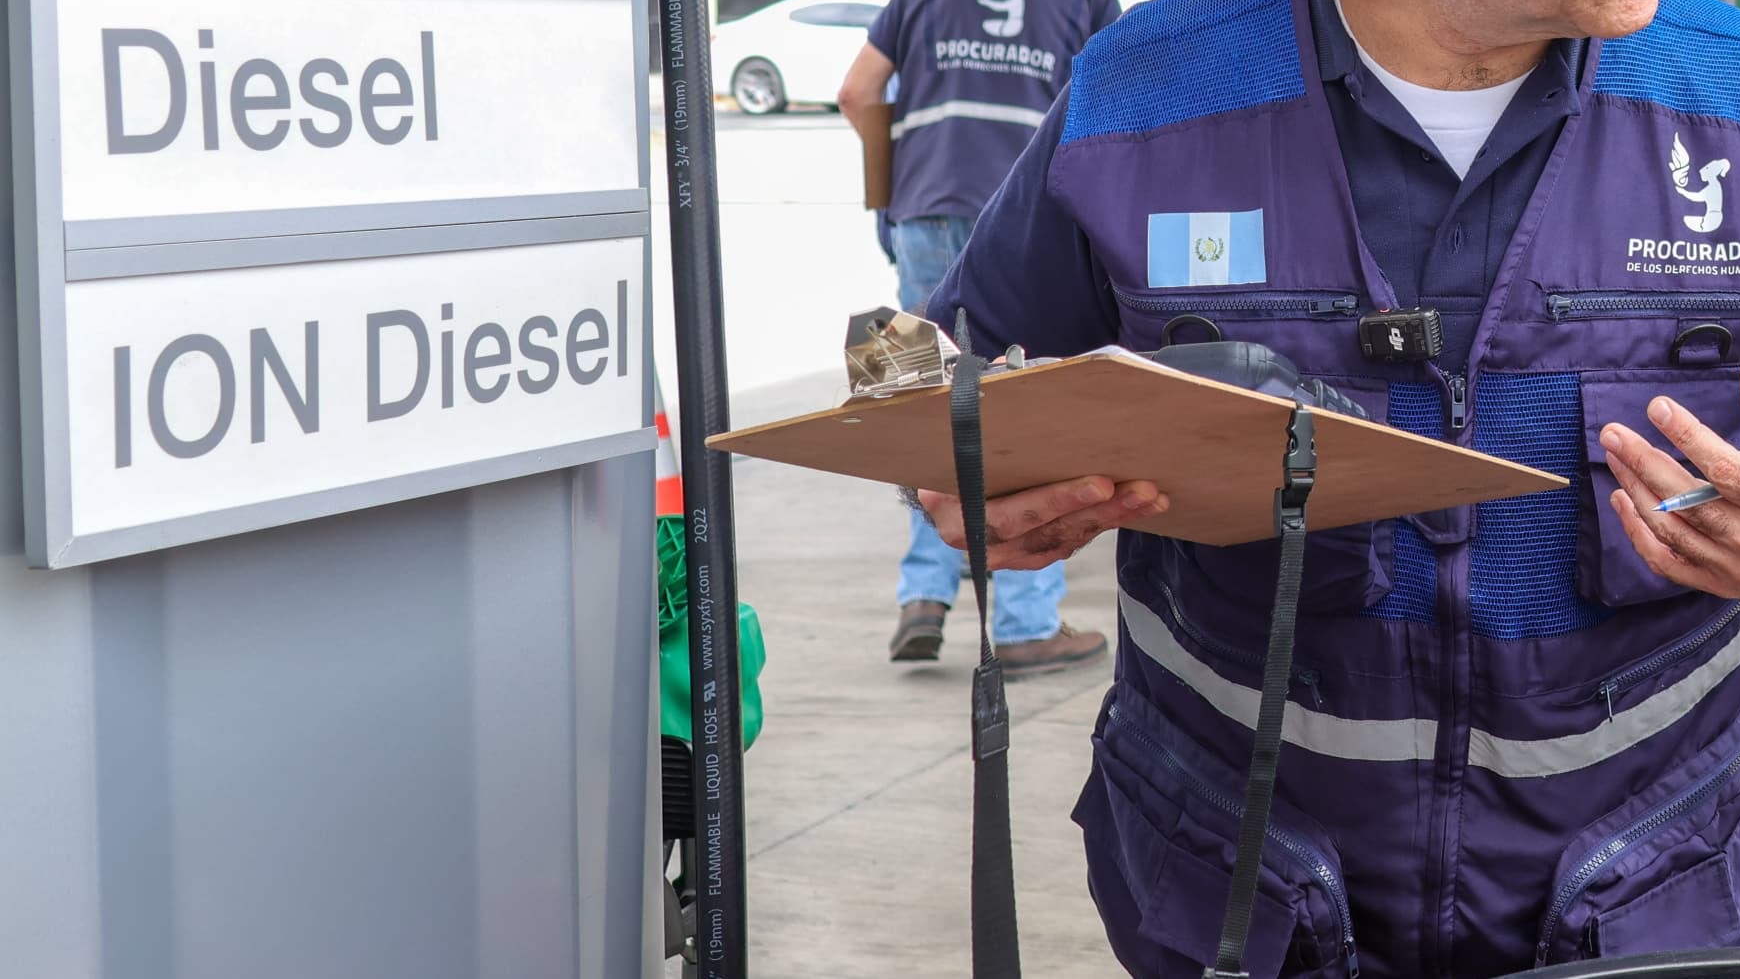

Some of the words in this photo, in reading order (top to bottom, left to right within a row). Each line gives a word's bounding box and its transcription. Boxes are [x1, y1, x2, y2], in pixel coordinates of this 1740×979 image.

[935, 39, 1056, 71] PROCURADOR
[101, 27, 439, 156] Diesel
[671, 79, 689, 131] (19mm)
[1627, 262, 1641, 272] DE
[1643, 263, 1662, 273] LOS
[1665, 264, 1718, 276] DERECHOS
[114, 321, 320, 469] ION
[366, 279, 628, 422] Diesel
[693, 507, 708, 544] 2Q22
[697, 565, 715, 670] www.syxfy.com
[703, 708, 718, 745] HOSE
[705, 753, 720, 800] LIQUID
[707, 812, 722, 896] FLAMMABLE
[707, 908, 724, 961] (19mm)
